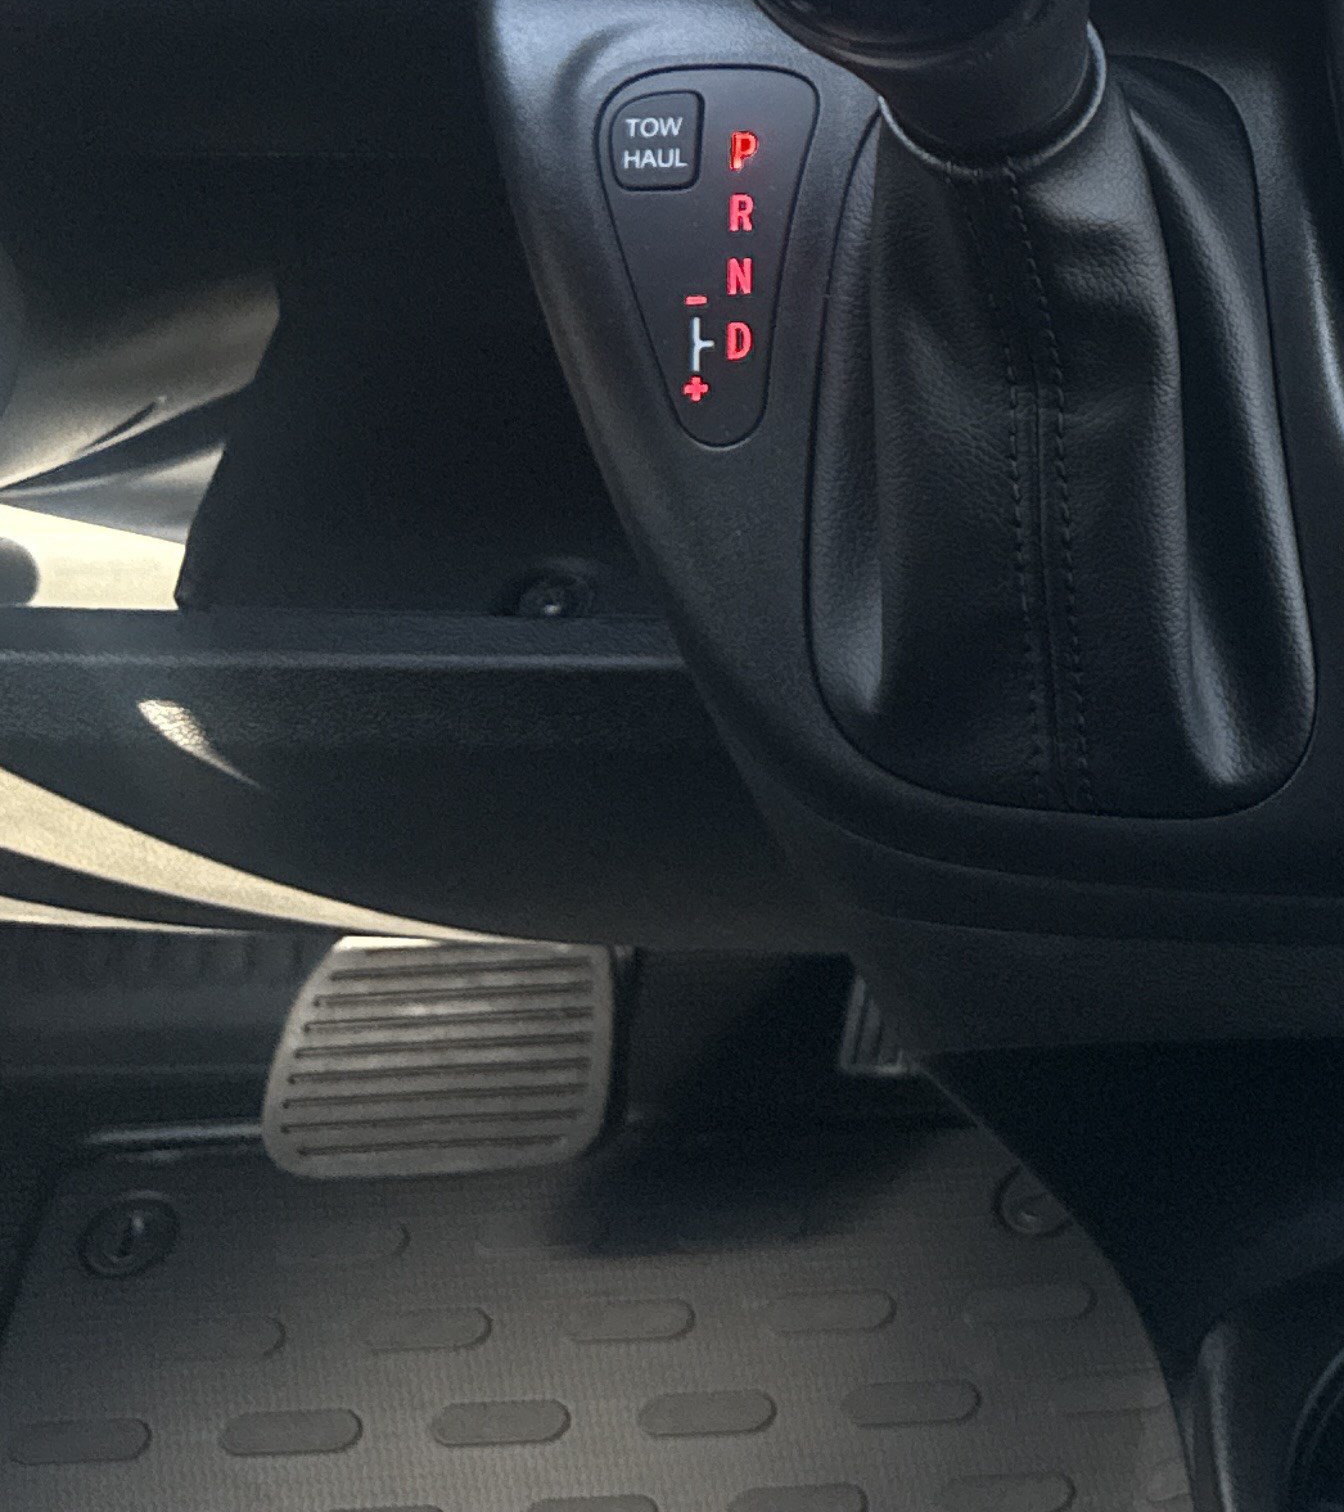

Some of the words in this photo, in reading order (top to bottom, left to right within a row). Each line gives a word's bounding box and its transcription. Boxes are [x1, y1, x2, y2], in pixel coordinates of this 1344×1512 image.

[626, 117, 682, 137] TOW
[623, 149, 688, 170] HAUL
[729, 130, 759, 172] P
[728, 193, 755, 232] R
[726, 257, 753, 296] N
[725, 321, 752, 361] D
